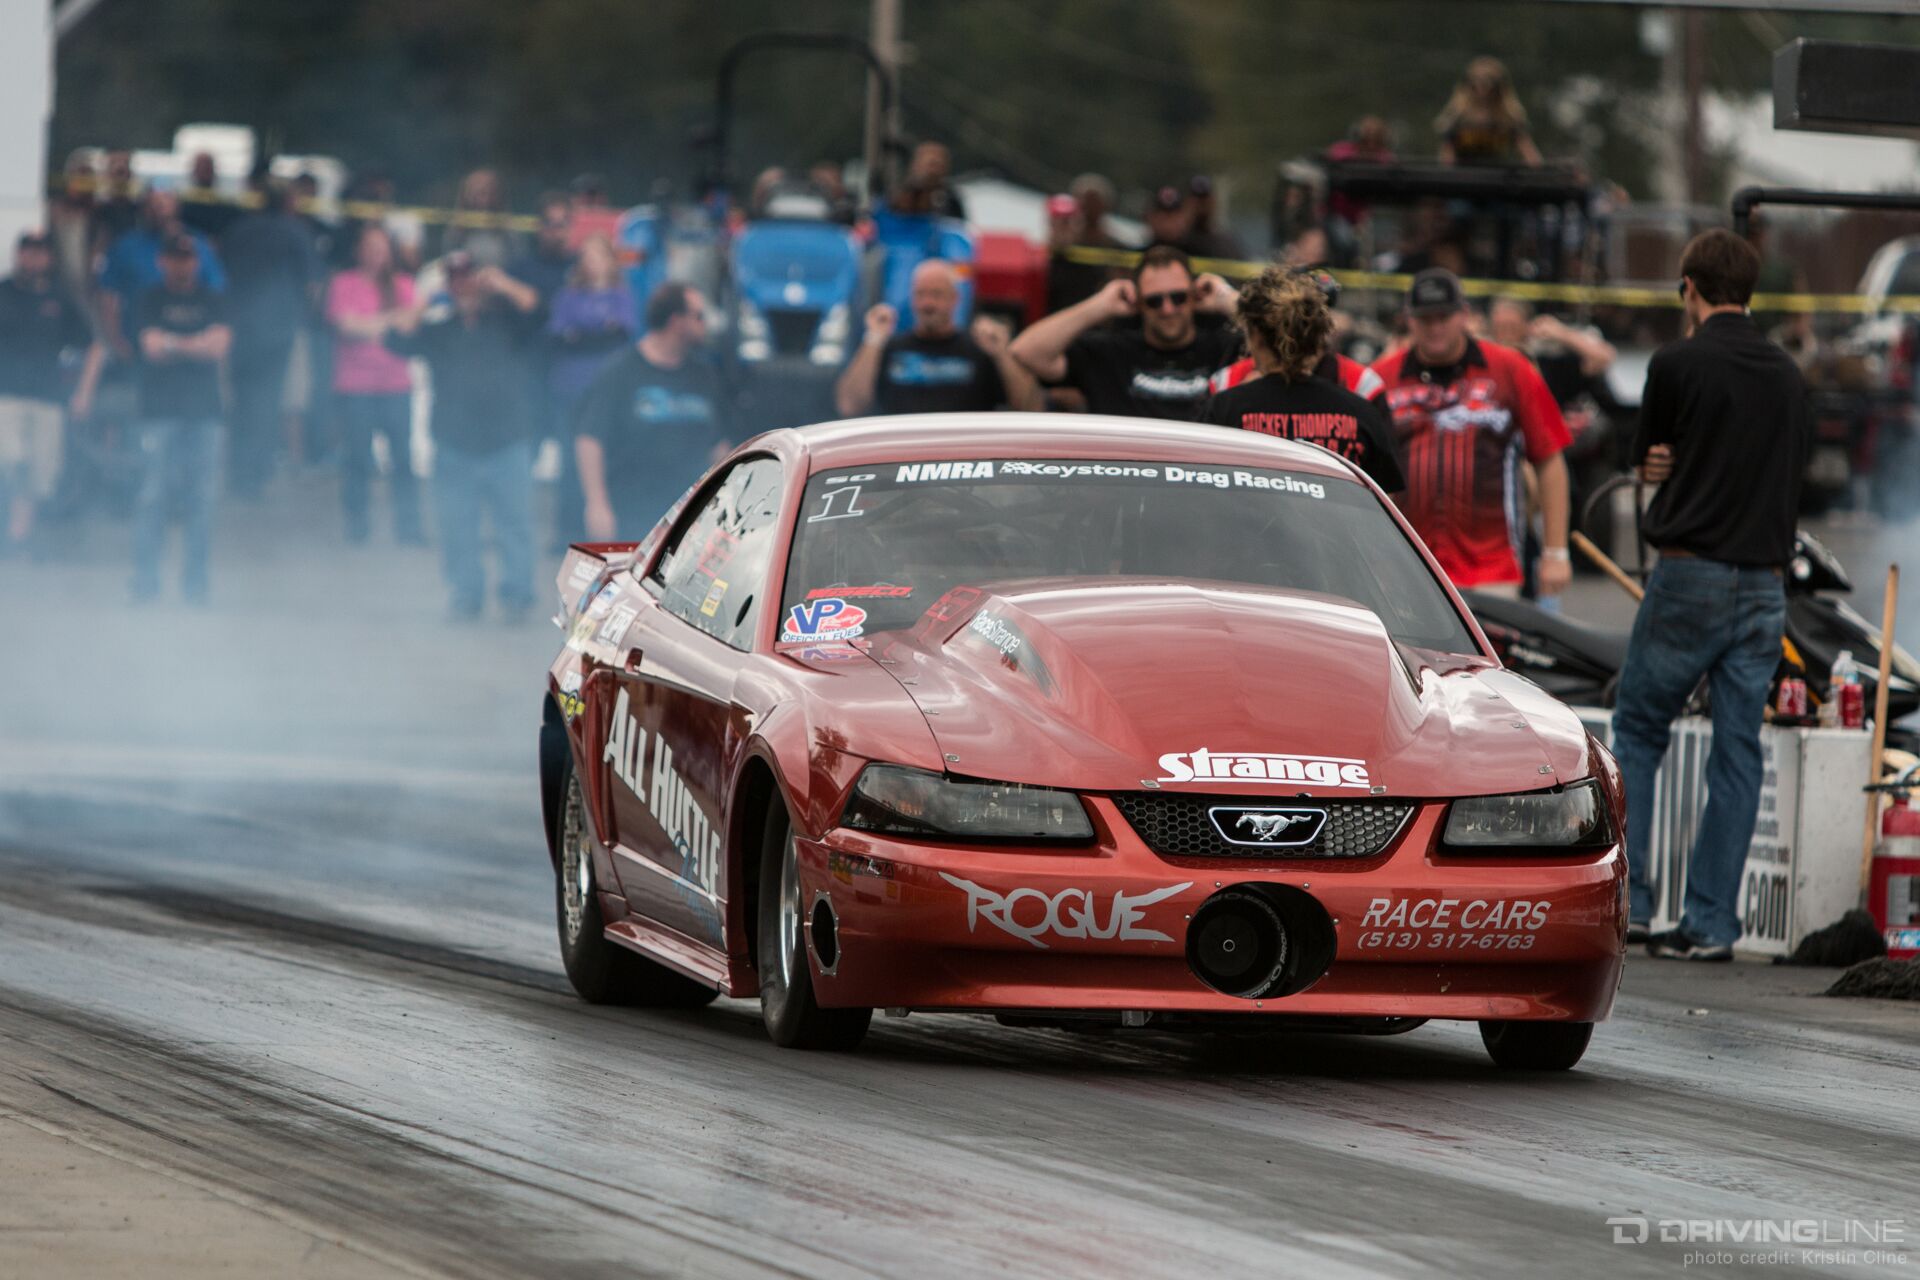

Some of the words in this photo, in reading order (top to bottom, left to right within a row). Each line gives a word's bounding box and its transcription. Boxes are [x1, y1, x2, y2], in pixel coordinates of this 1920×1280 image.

[1242, 412, 1289, 437] MICKEY
[1291, 413, 1358, 440] THOMPSON
[896, 462, 994, 483] NMRA
[1027, 464, 1158, 478] Keystone
[1165, 467, 1229, 488] Drag
[1233, 471, 1325, 499] Racing
[807, 486, 864, 523] 1
[790, 598, 845, 635] VP
[832, 627, 860, 641] FUEL
[1157, 747, 1370, 788] Strange
[938, 872, 1194, 948] ROGUE
[1360, 898, 1459, 927] RACE
[1460, 899, 1551, 930] CARS
[1357, 932, 1421, 950] (513)
[1427, 933, 1536, 950] 317-6763
